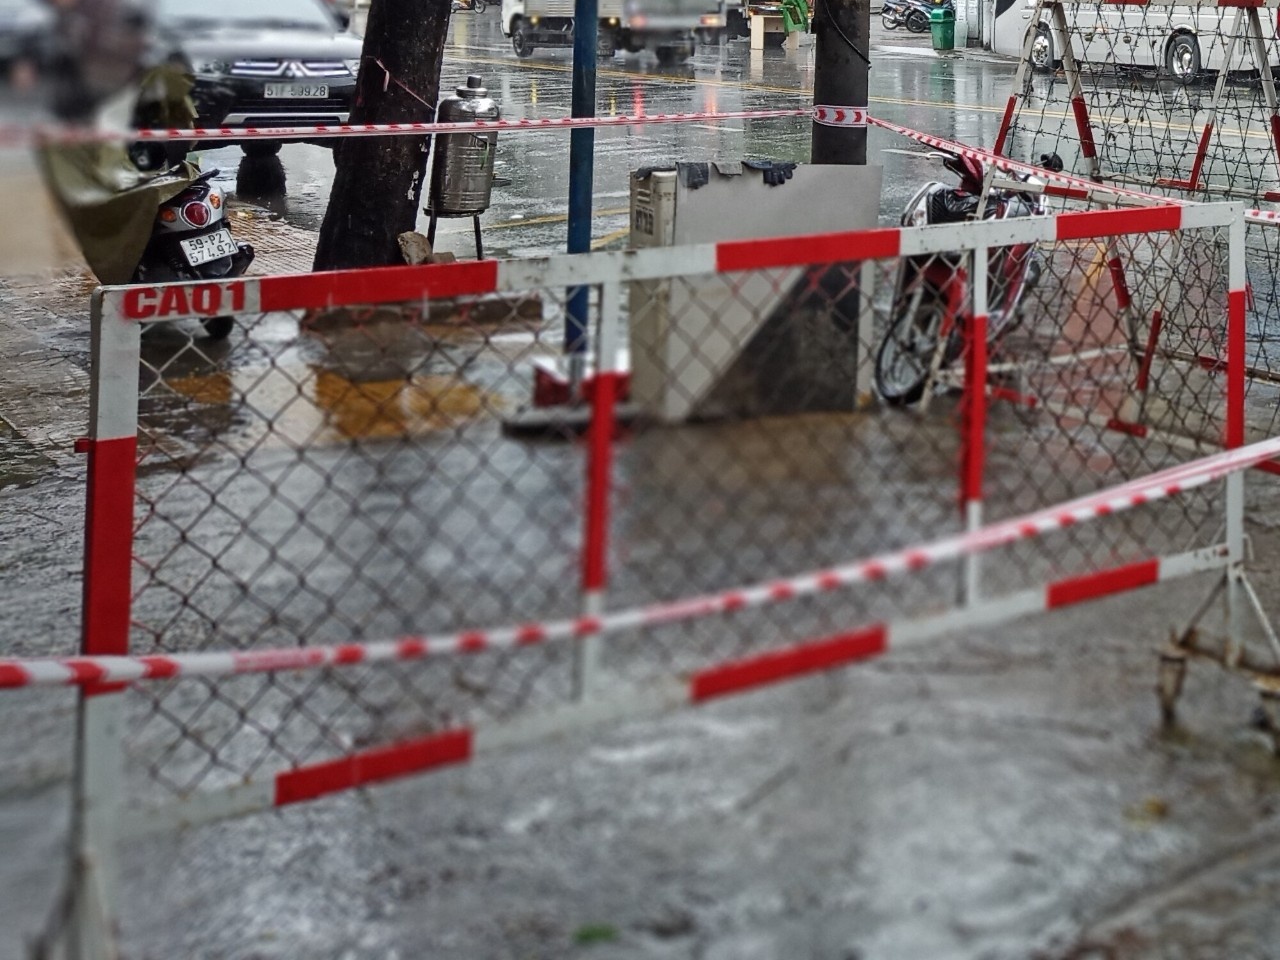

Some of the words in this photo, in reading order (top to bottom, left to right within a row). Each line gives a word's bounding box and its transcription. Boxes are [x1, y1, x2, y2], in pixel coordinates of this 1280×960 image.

[188, 232, 225, 251] 59-P2
[188, 242, 235, 265] 574.92
[124, 280, 246, 320] CAQ1
